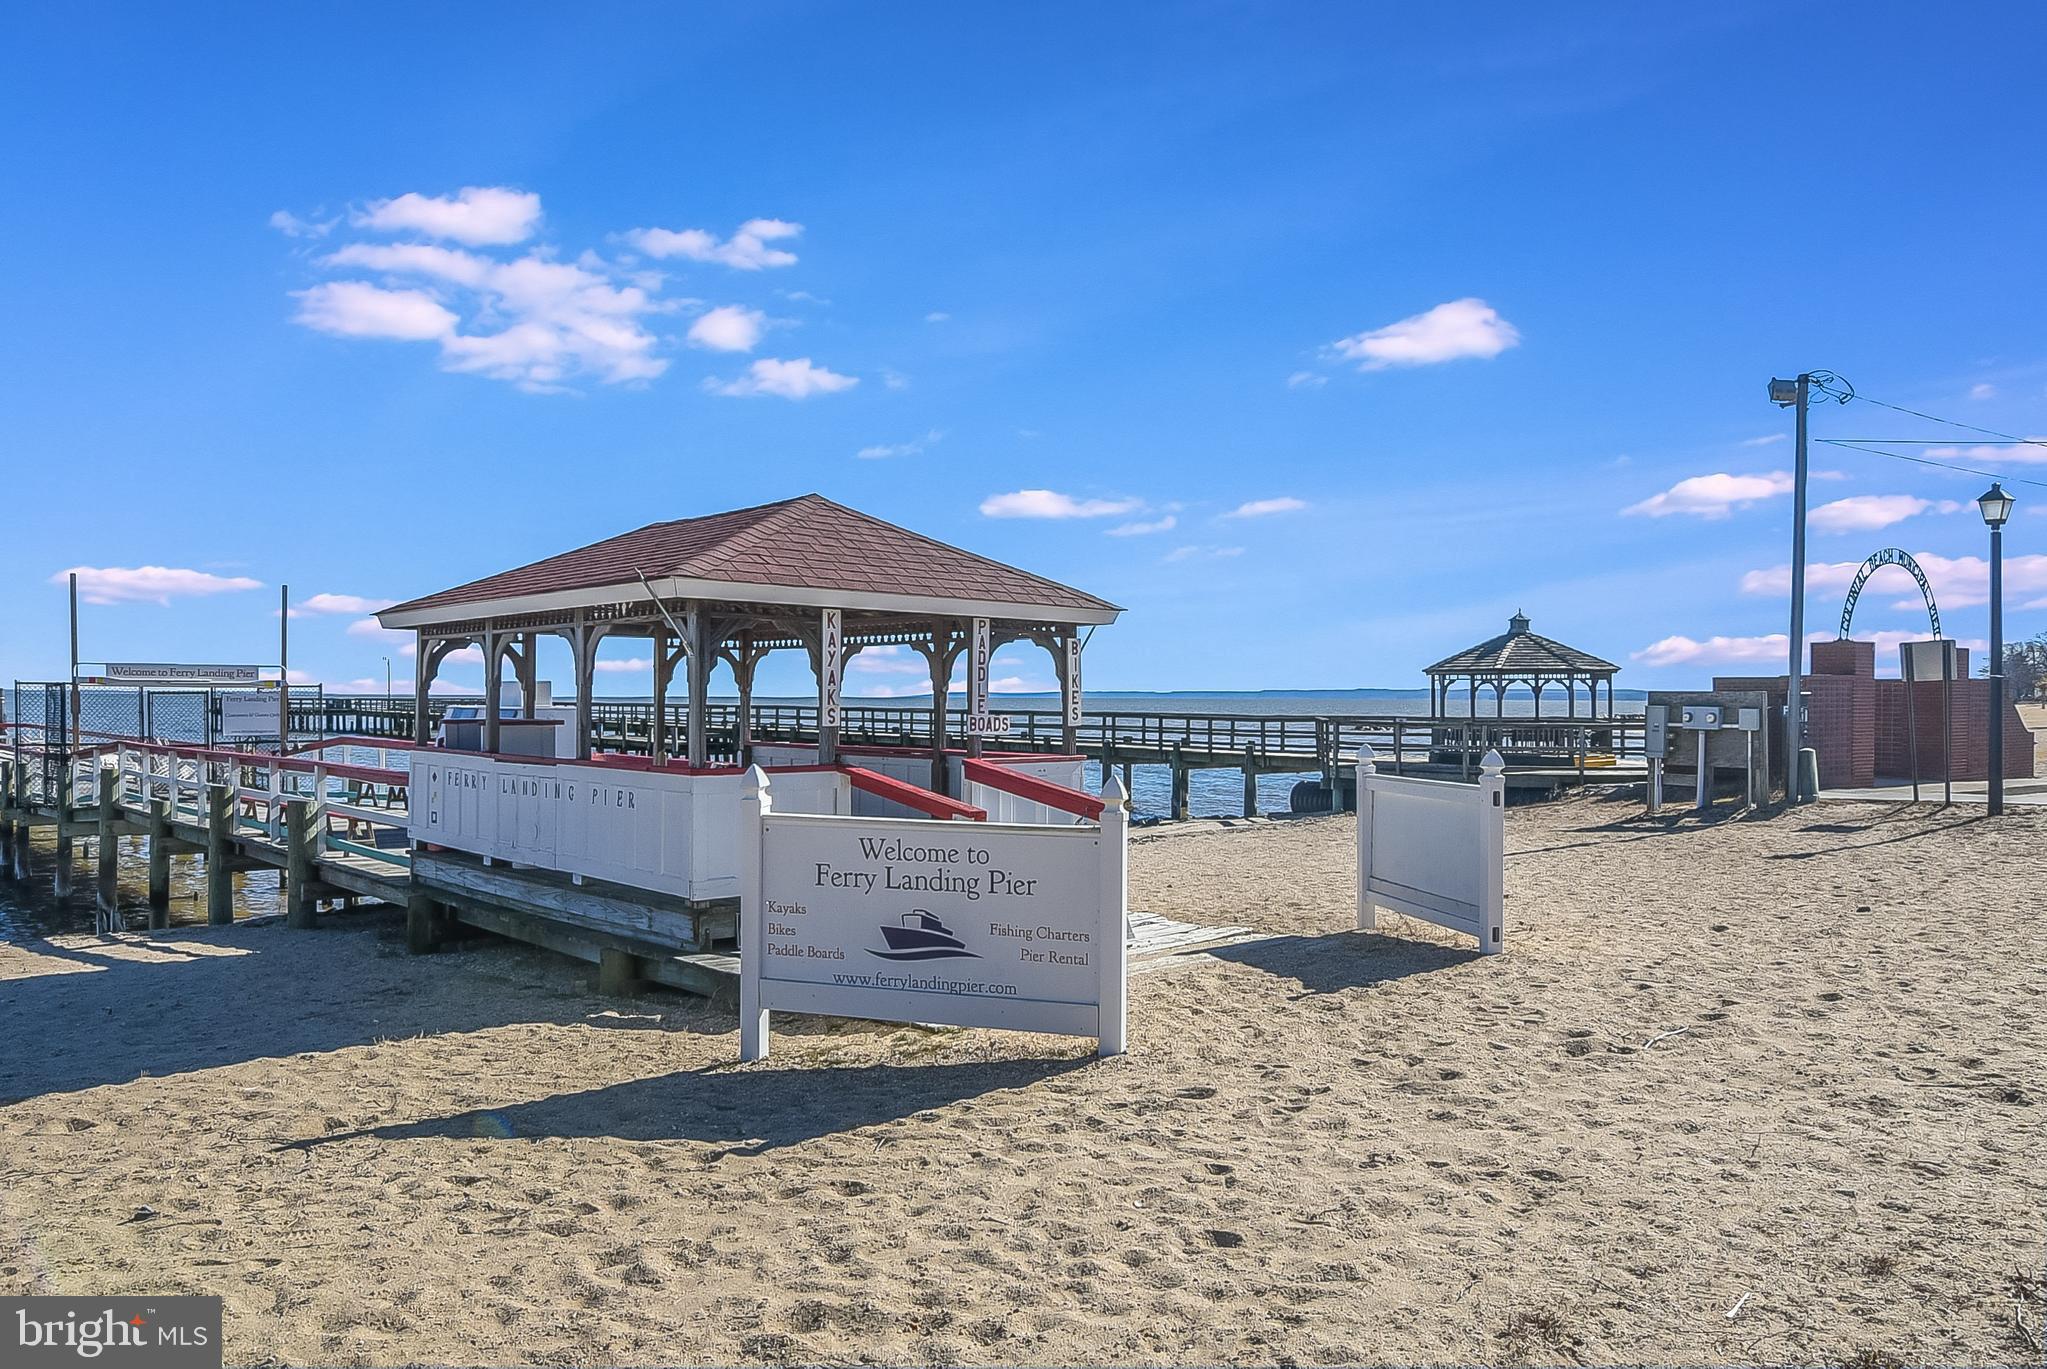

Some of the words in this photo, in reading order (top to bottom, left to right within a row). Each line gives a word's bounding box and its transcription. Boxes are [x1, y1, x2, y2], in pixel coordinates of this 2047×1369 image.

[1868, 549, 1894, 571] BEACH
[1899, 550, 1929, 598] MUNICIPAL
[1929, 603, 1941, 634] PIER
[112, 666, 156, 677] Welcome
[158, 668, 168, 677] to
[170, 668, 195, 679] Ferry
[197, 669, 235, 680] Landing
[236, 669, 255, 678] Pier
[826, 612, 836, 725] KAYAKS
[977, 620, 987, 714] PADDLE
[1071, 640, 1079, 721] BIKES
[969, 717, 1009, 732] BOADS
[447, 771, 487, 791] FERRY
[502, 778, 575, 801] LANDING
[592, 788, 635, 809] PIER
[858, 836, 960, 864] Welcome
[967, 847, 990, 865] to
[815, 863, 877, 895] Ferry
[884, 866, 981, 901] Landing
[987, 870, 1037, 896] Pier
[767, 901, 807, 916] Kayaks
[768, 923, 797, 936] Bikes
[989, 922, 1033, 940] Fishing
[1036, 926, 1090, 943] Charters
[767, 943, 804, 957] Paddle
[807, 946, 845, 960] Boards
[1020, 948, 1046, 963] Pier
[1049, 950, 1089, 965] Rental
[833, 973, 1018, 996] www.ferrylandingpier.com
